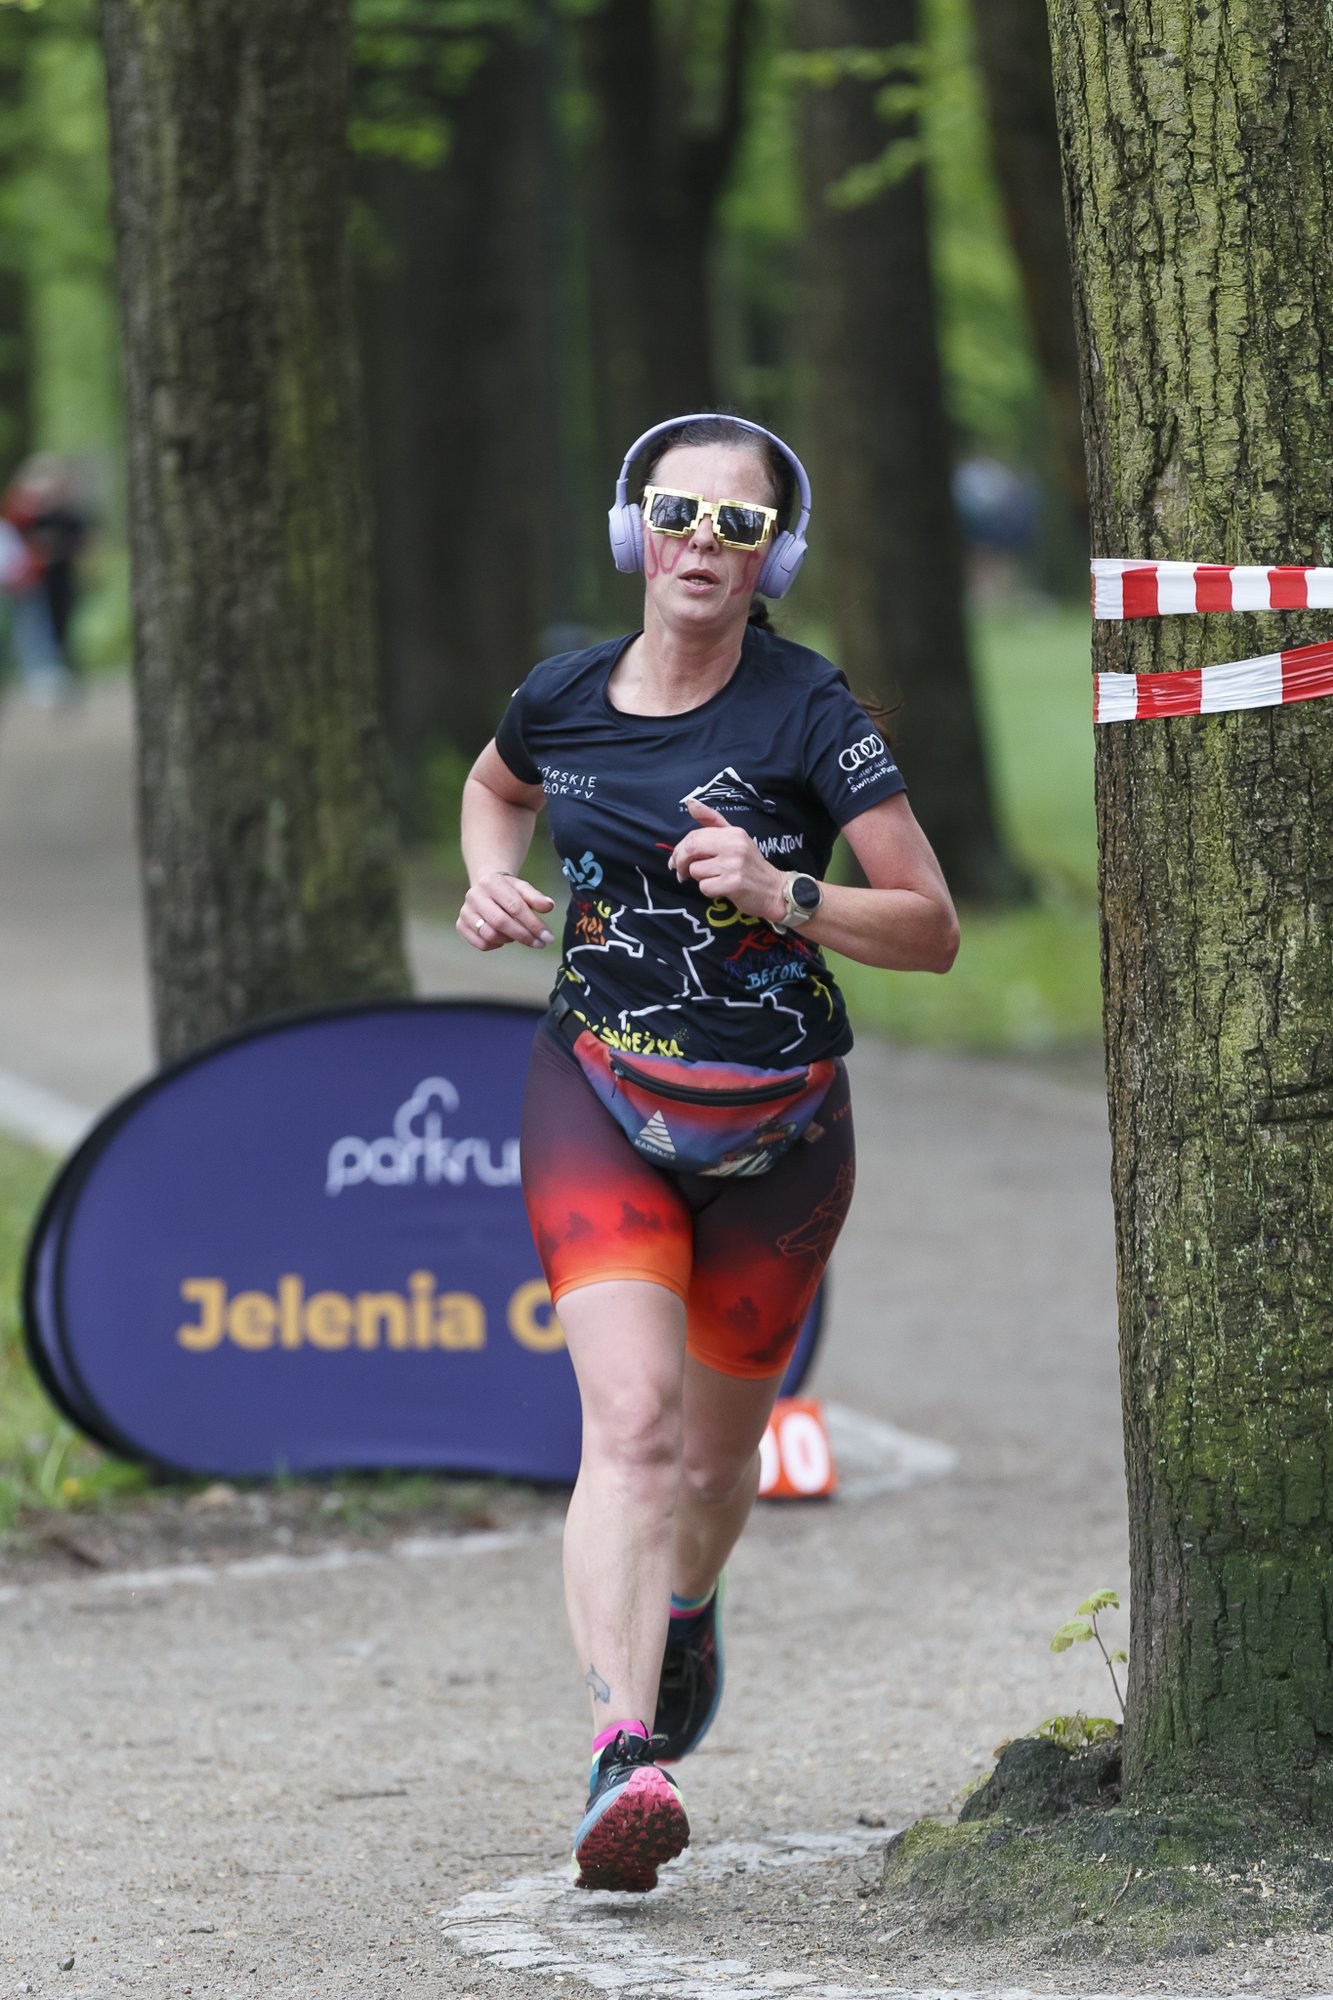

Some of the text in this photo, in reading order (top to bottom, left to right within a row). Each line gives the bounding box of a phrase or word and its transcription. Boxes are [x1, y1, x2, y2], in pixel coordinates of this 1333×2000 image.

[538, 765, 597, 788] ÓRSKIE
[325, 1076, 522, 1197] parkru
[178, 1268, 567, 1353] Jelenia G
